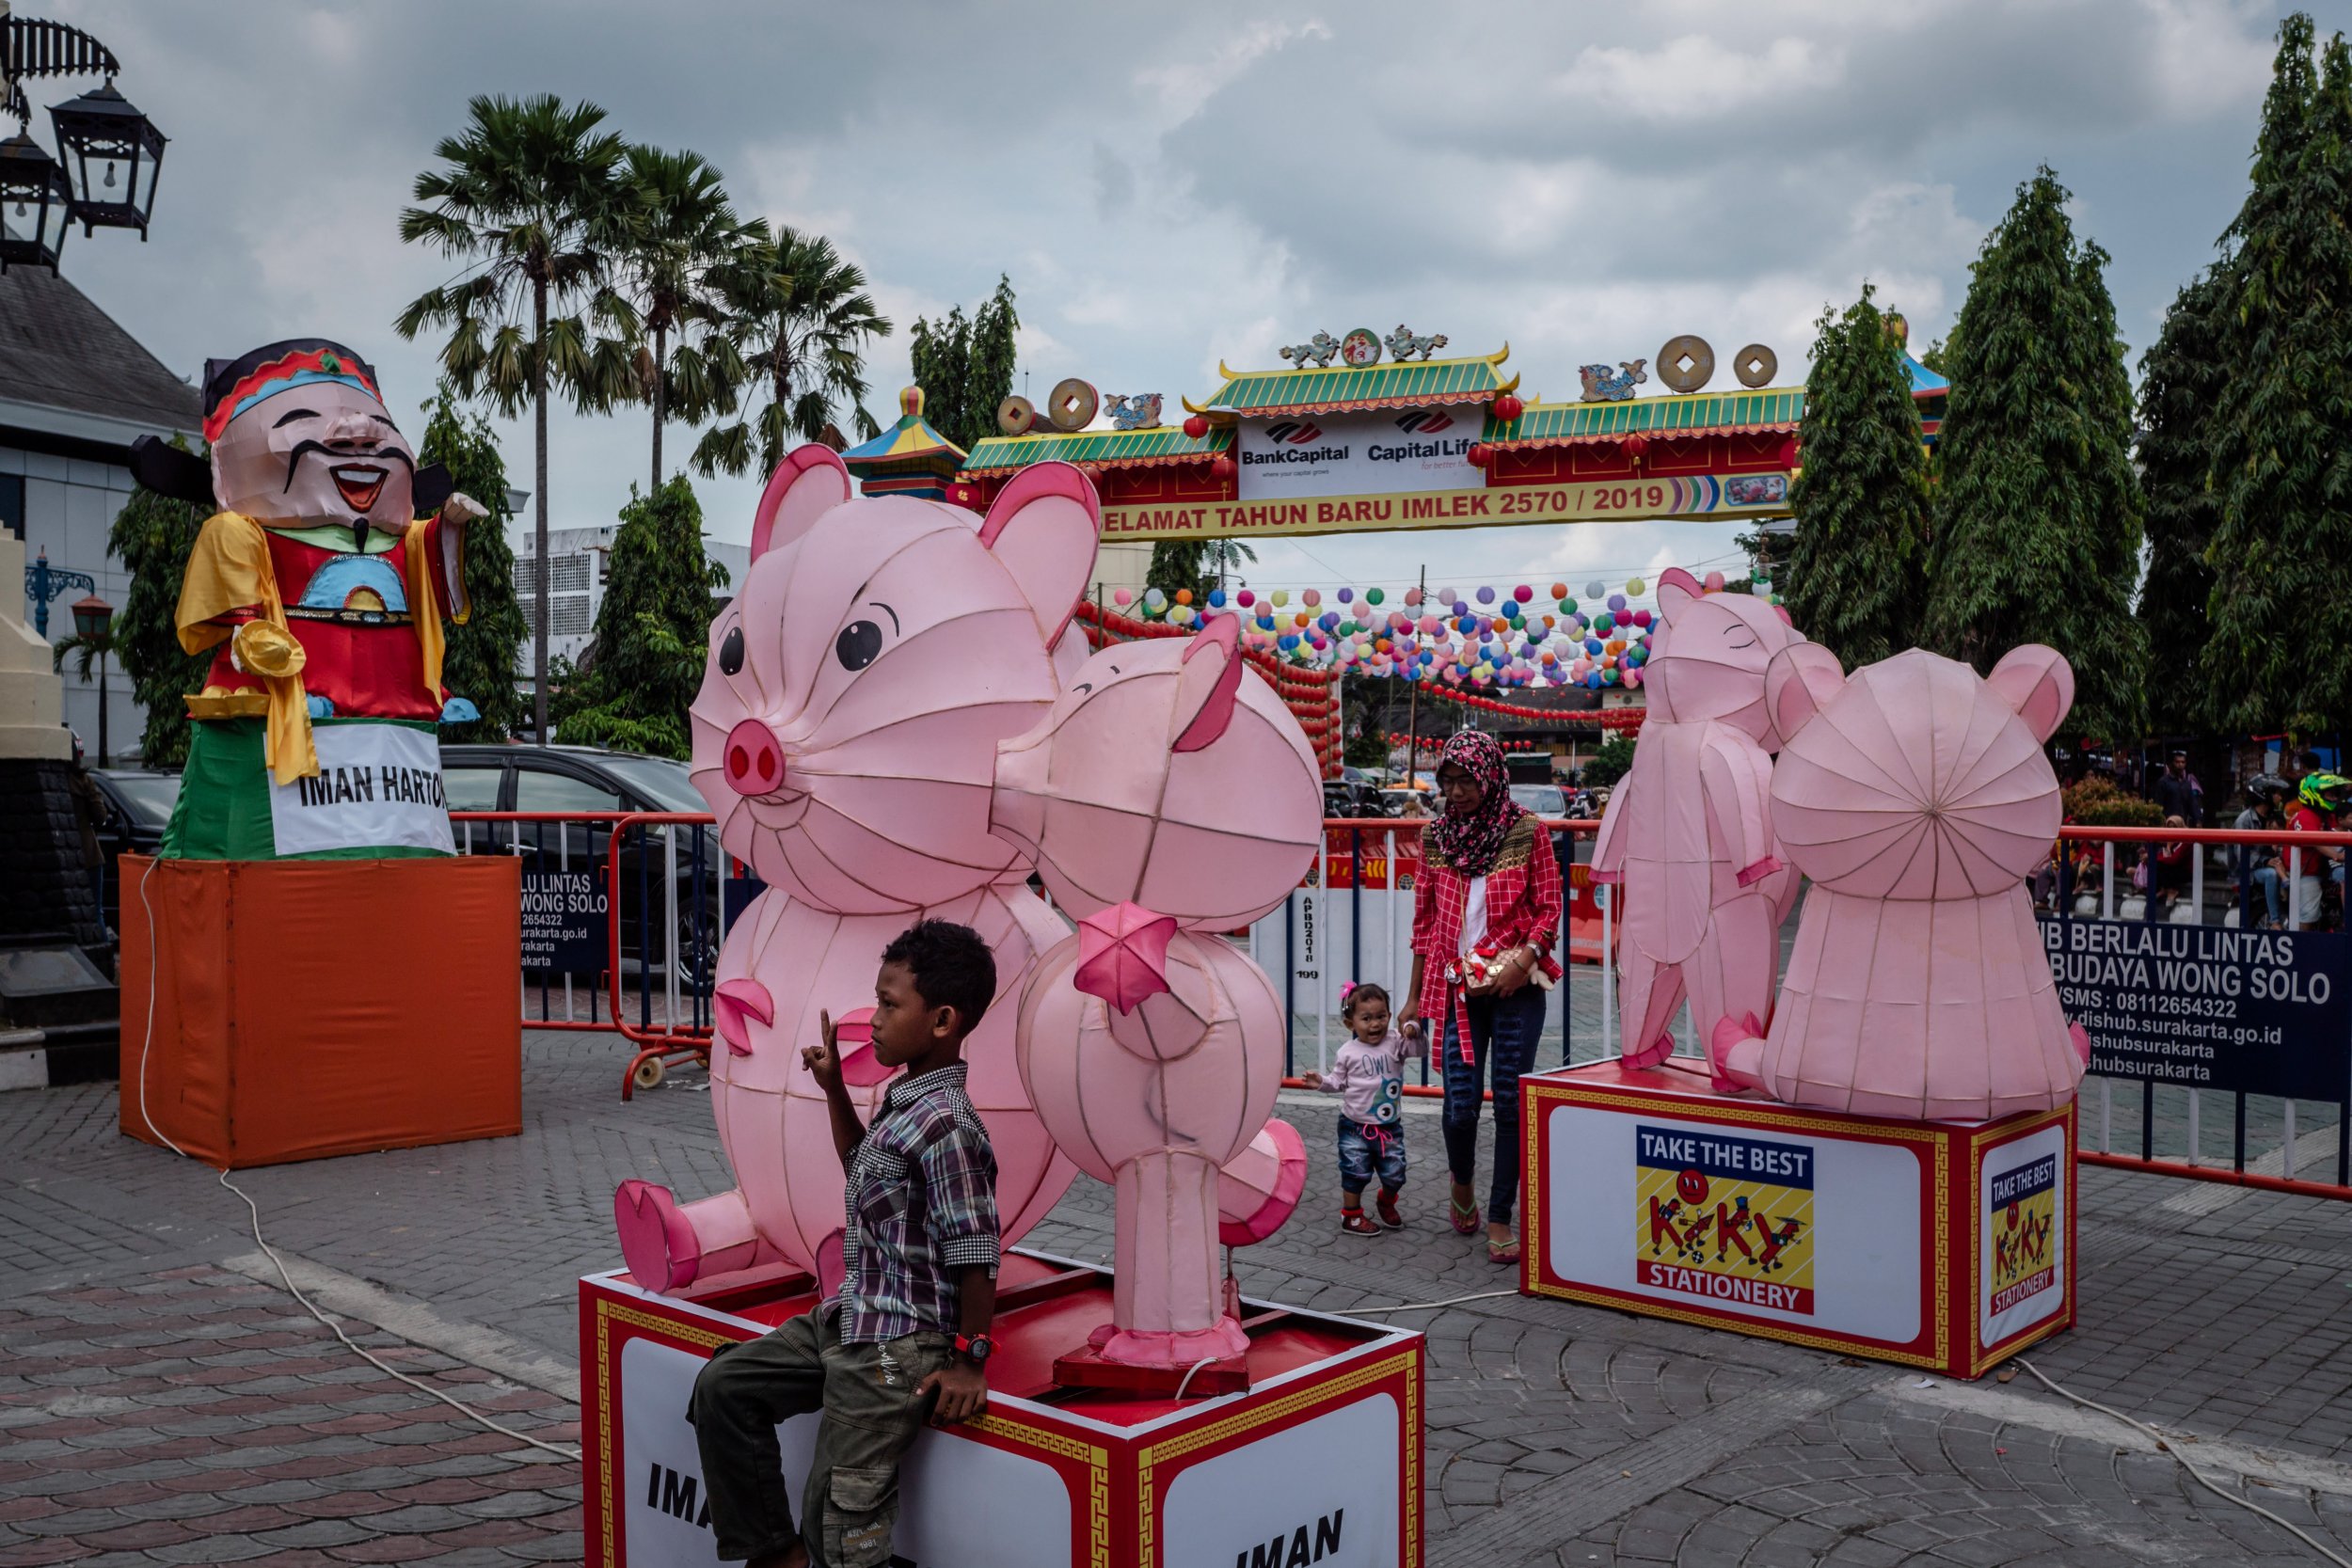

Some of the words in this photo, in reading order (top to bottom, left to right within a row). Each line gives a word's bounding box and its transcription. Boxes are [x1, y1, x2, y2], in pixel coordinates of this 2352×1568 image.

[1242, 446, 1349, 465] BankCapital
[1368, 440, 1439, 463] Capital
[1102, 509, 1207, 532] ELAMAT
[1216, 504, 1307, 528] TAHUN
[1317, 499, 1392, 524] BARU
[1402, 494, 1490, 519] IMLEK
[1500, 490, 1568, 515] 2570
[1594, 485, 1664, 510] 2019
[298, 767, 374, 807] IMAN
[541, 875, 591, 893] LINTAS
[520, 895, 564, 912] WONG
[568, 895, 608, 913] SOLO
[522, 914, 563, 926] 2654322
[520, 927, 587, 941] urakarta.go.id
[520, 941, 555, 952] rakarta
[2038, 921, 2063, 950] IB
[2071, 923, 2189, 958] BERLALU
[2198, 930, 2294, 967] LINTAS
[520, 955, 551, 966] akarta
[2049, 952, 2151, 990] BUDAYA
[2156, 959, 2242, 997] WONG
[2249, 967, 2331, 1006] SOLO
[2117, 992, 2237, 1019] 08112654322
[1362, 1053, 1391, 1077] OWL
[1641, 1132, 1696, 1164] TAKE
[1700, 1140, 1744, 1169] THE
[1750, 1147, 1808, 1178] BEST
[1993, 1176, 2015, 1203] TAKE
[2016, 1168, 2033, 1193] THE
[2033, 1160, 2054, 1187] BEST
[1649, 1263, 1800, 1310] STATIONERY
[1994, 1269, 2050, 1313] STATIONERY
